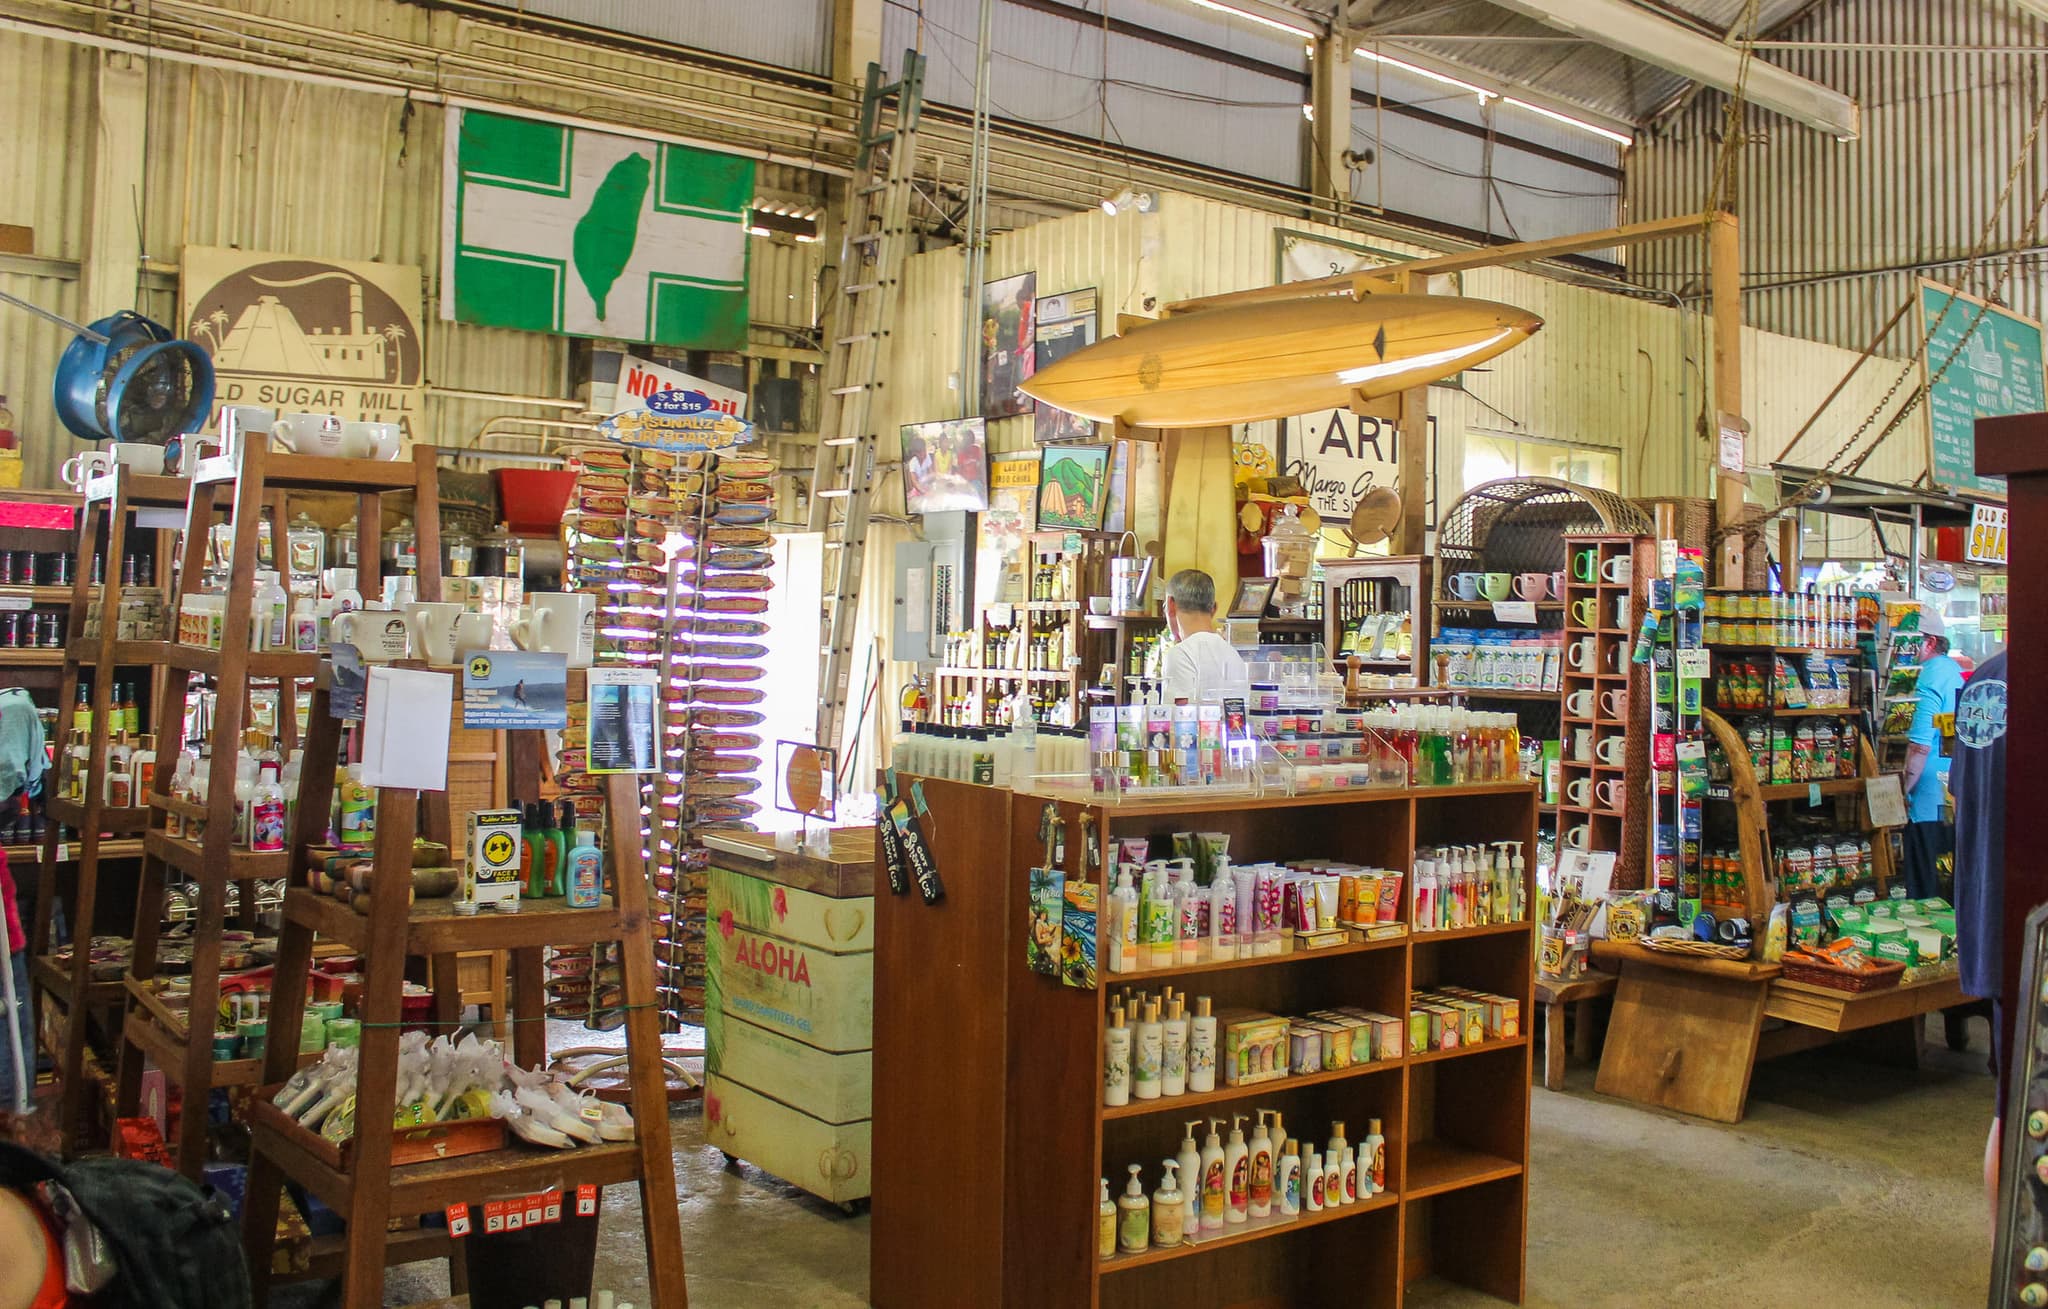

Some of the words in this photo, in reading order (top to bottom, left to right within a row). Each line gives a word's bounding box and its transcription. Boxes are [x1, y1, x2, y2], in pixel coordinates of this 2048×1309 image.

[626, 367, 658, 399] NO
[258, 385, 345, 408] SUGAR
[359, 391, 413, 411] MILL
[654, 402, 661, 410] 2
[663, 402, 680, 410] for
[682, 403, 701, 411] $15
[672, 392, 685, 402] $8
[719, 482, 765, 495] CARLOS
[1317, 497, 1338, 512] THE
[1977, 509, 1997, 522] OLD
[903, 831, 923, 877] Shave
[918, 870, 933, 898] Ice
[735, 934, 812, 988] ALOHA
